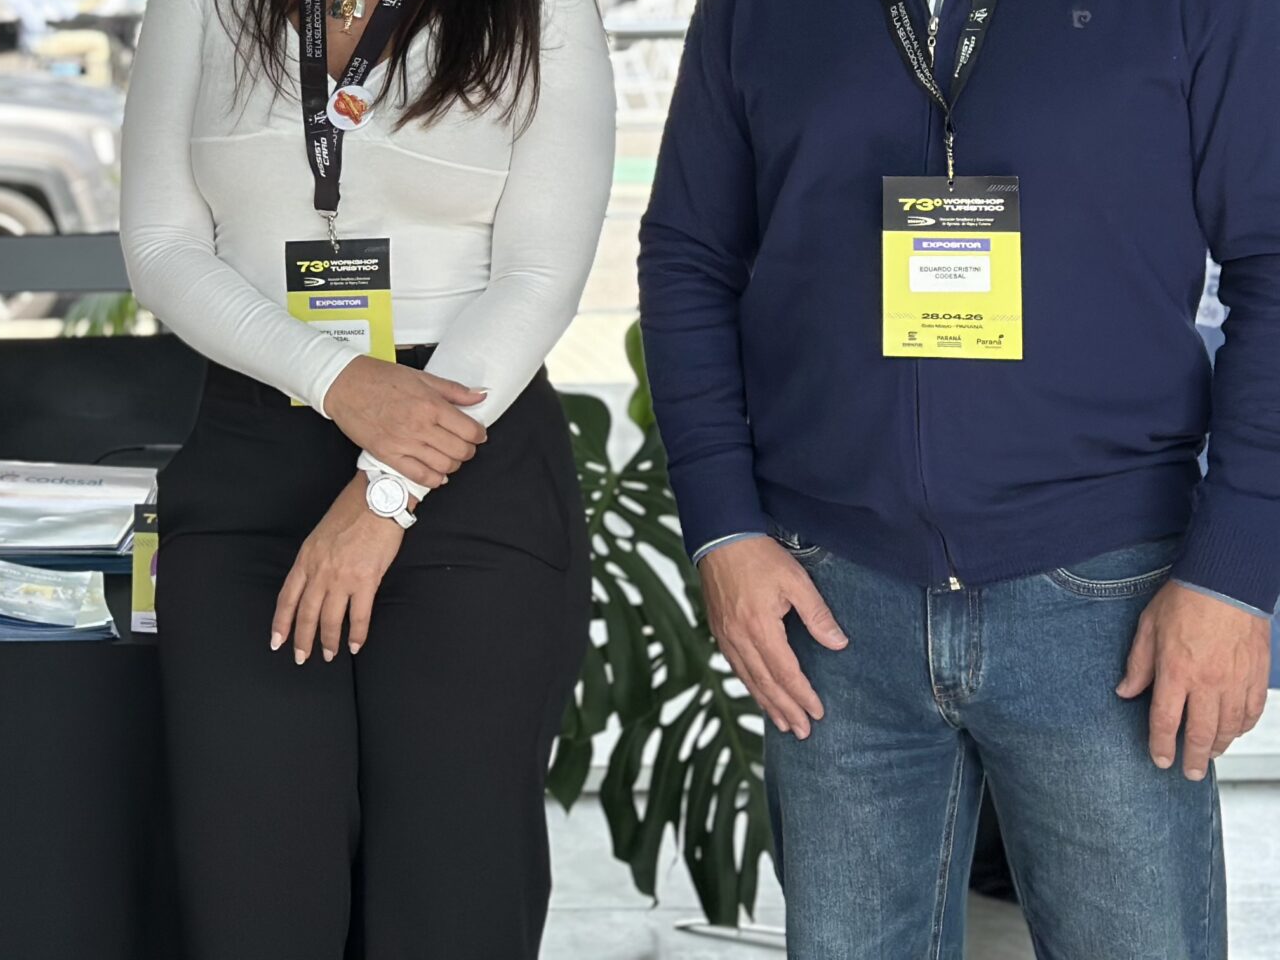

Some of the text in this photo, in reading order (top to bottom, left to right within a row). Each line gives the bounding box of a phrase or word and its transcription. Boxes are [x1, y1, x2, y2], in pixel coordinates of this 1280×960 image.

[314, 139, 326, 177] ASSIST
[320, 136, 329, 166] CARD
[25, 475, 104, 487] codesal
